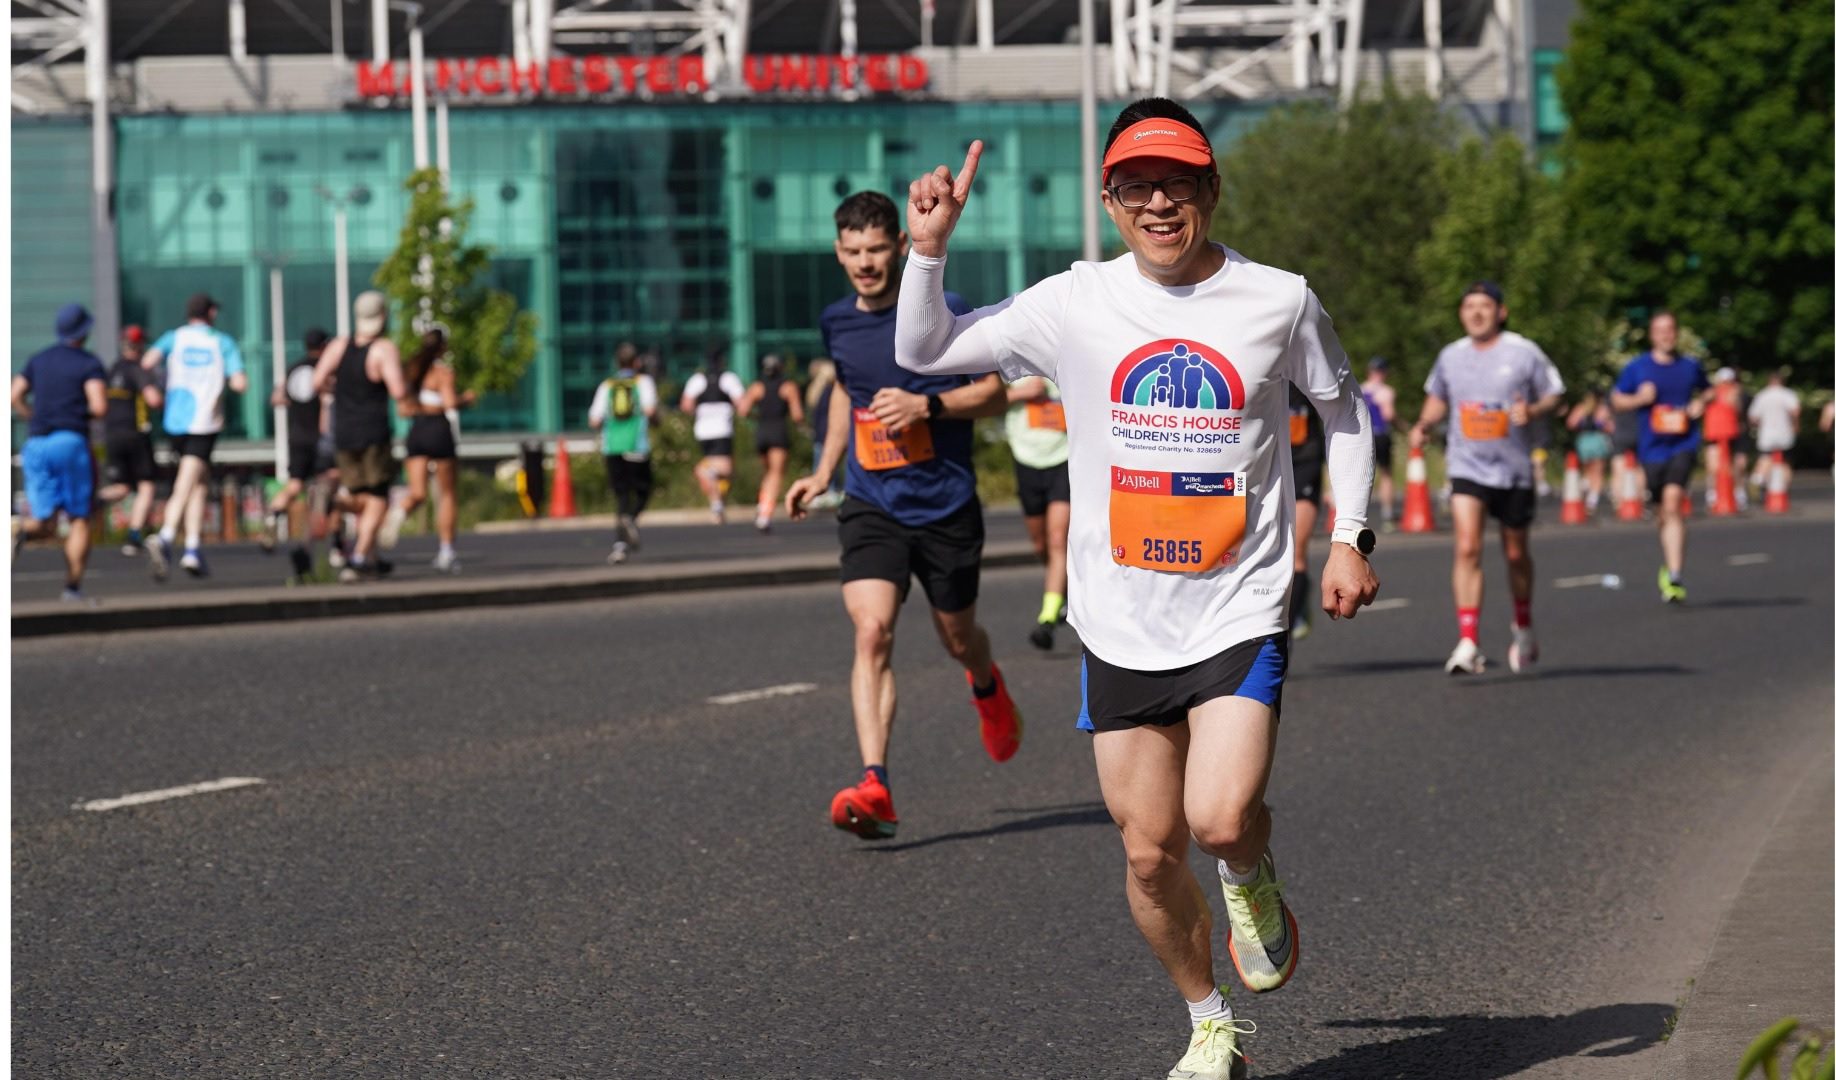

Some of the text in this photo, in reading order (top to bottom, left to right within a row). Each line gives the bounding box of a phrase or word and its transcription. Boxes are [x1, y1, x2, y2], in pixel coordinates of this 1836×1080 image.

[743, 54, 929, 92] UNITED
[1142, 129, 1178, 137] MONTANE
[1111, 409, 1242, 430] FRANCIS HOUSE
[1111, 426, 1241, 444] CHILDREN’S HOSPICE
[1125, 442, 1157, 452] Registered
[1158, 445, 1182, 453] Charity
[1143, 537, 1202, 564] 25855
